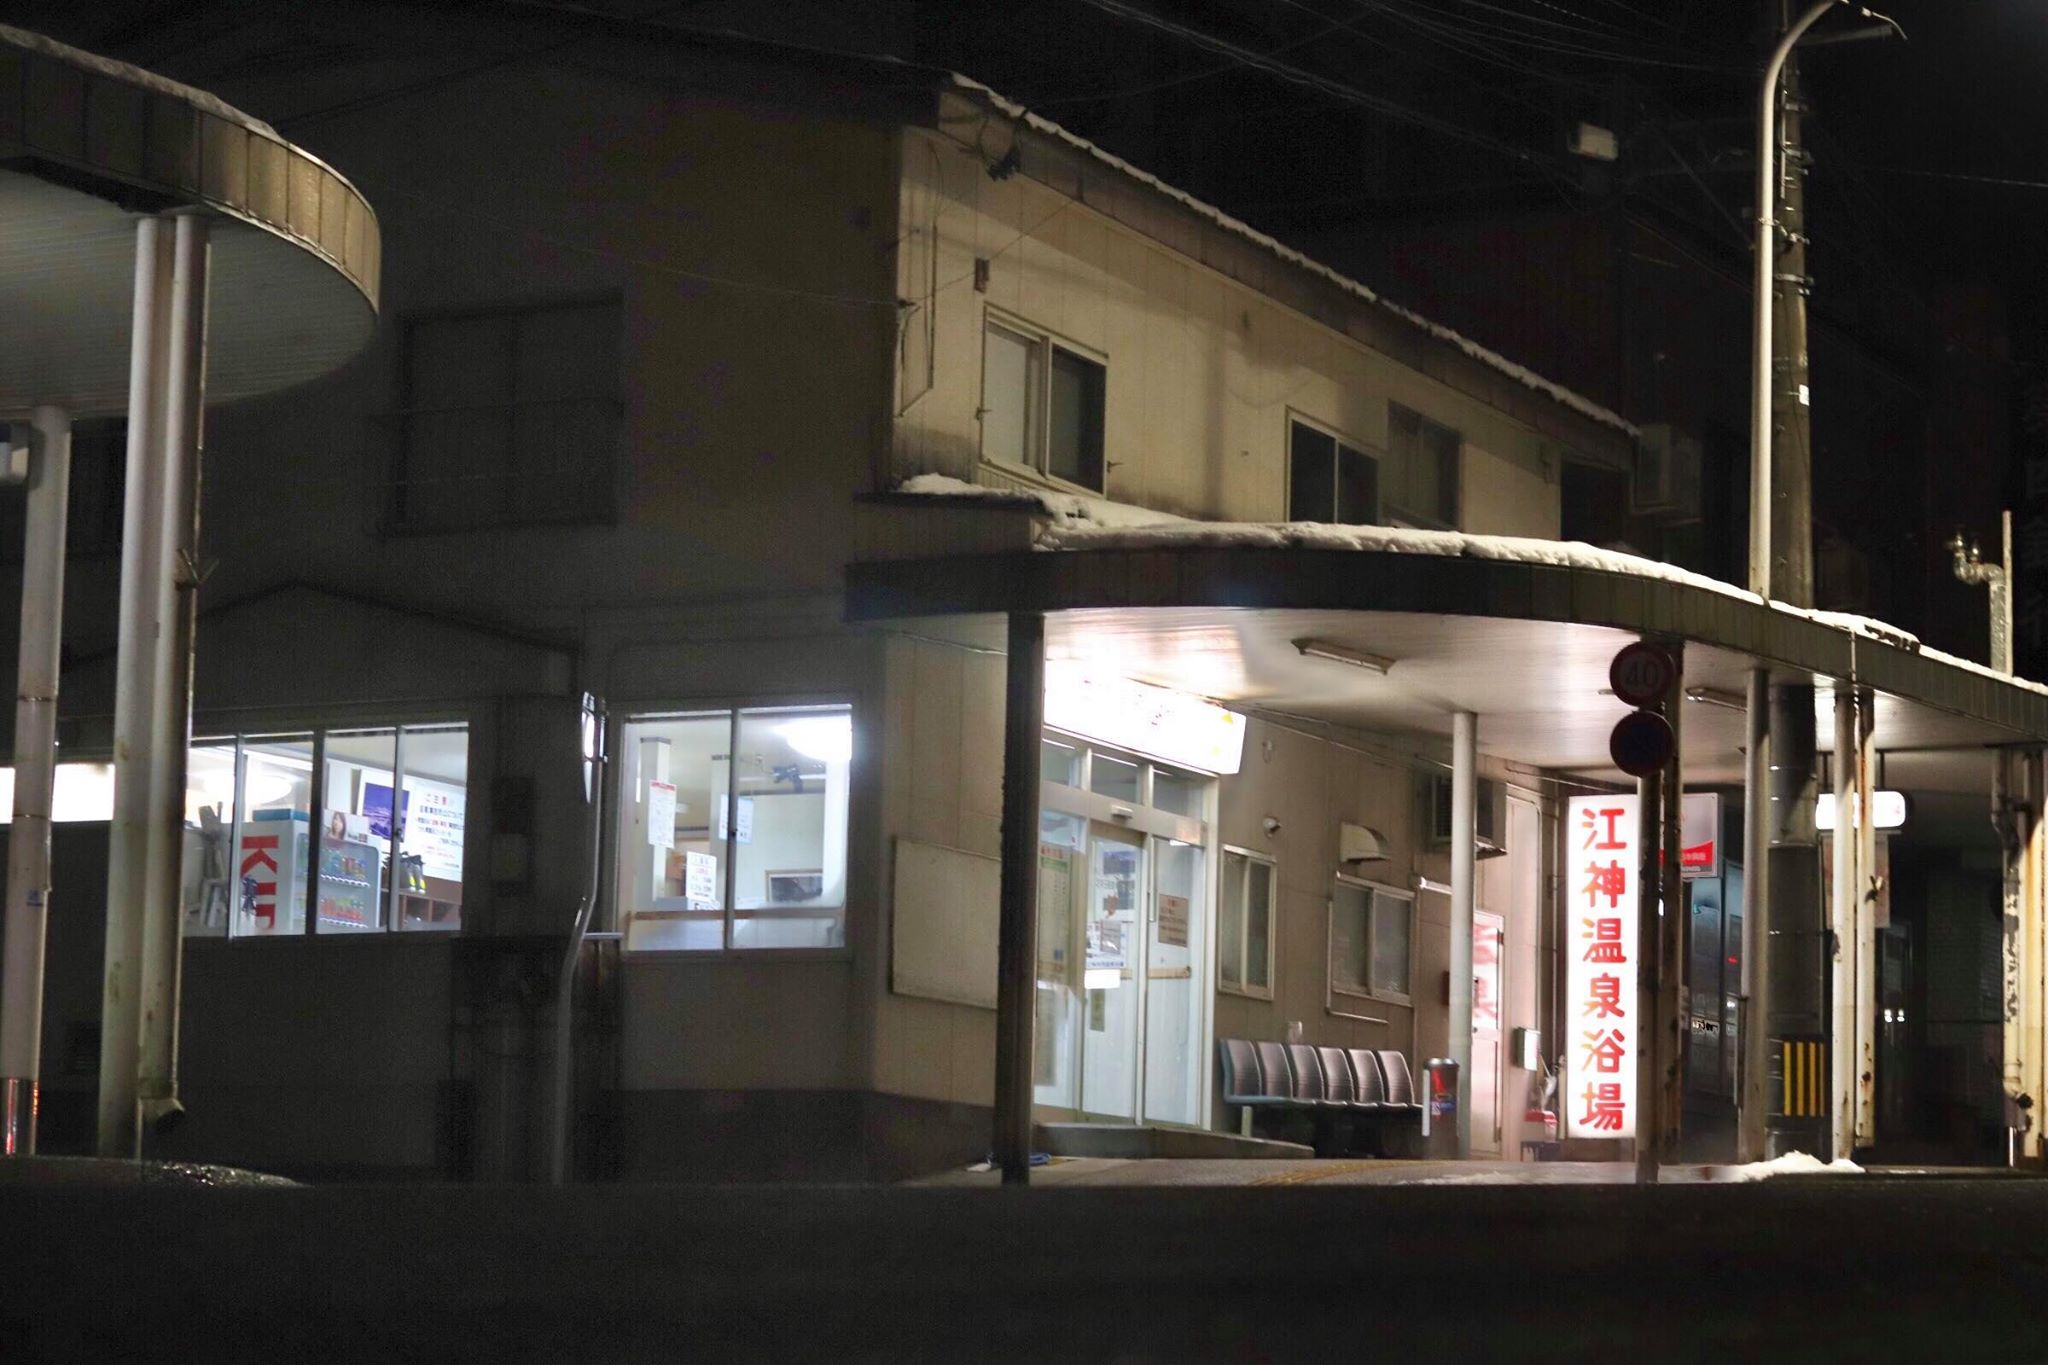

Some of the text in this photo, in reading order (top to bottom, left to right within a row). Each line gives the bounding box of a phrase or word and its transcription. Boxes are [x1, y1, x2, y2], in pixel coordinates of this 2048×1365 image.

[1626, 662, 1658, 686] 40
[1579, 808, 1628, 1132] 江神温泉浴場
